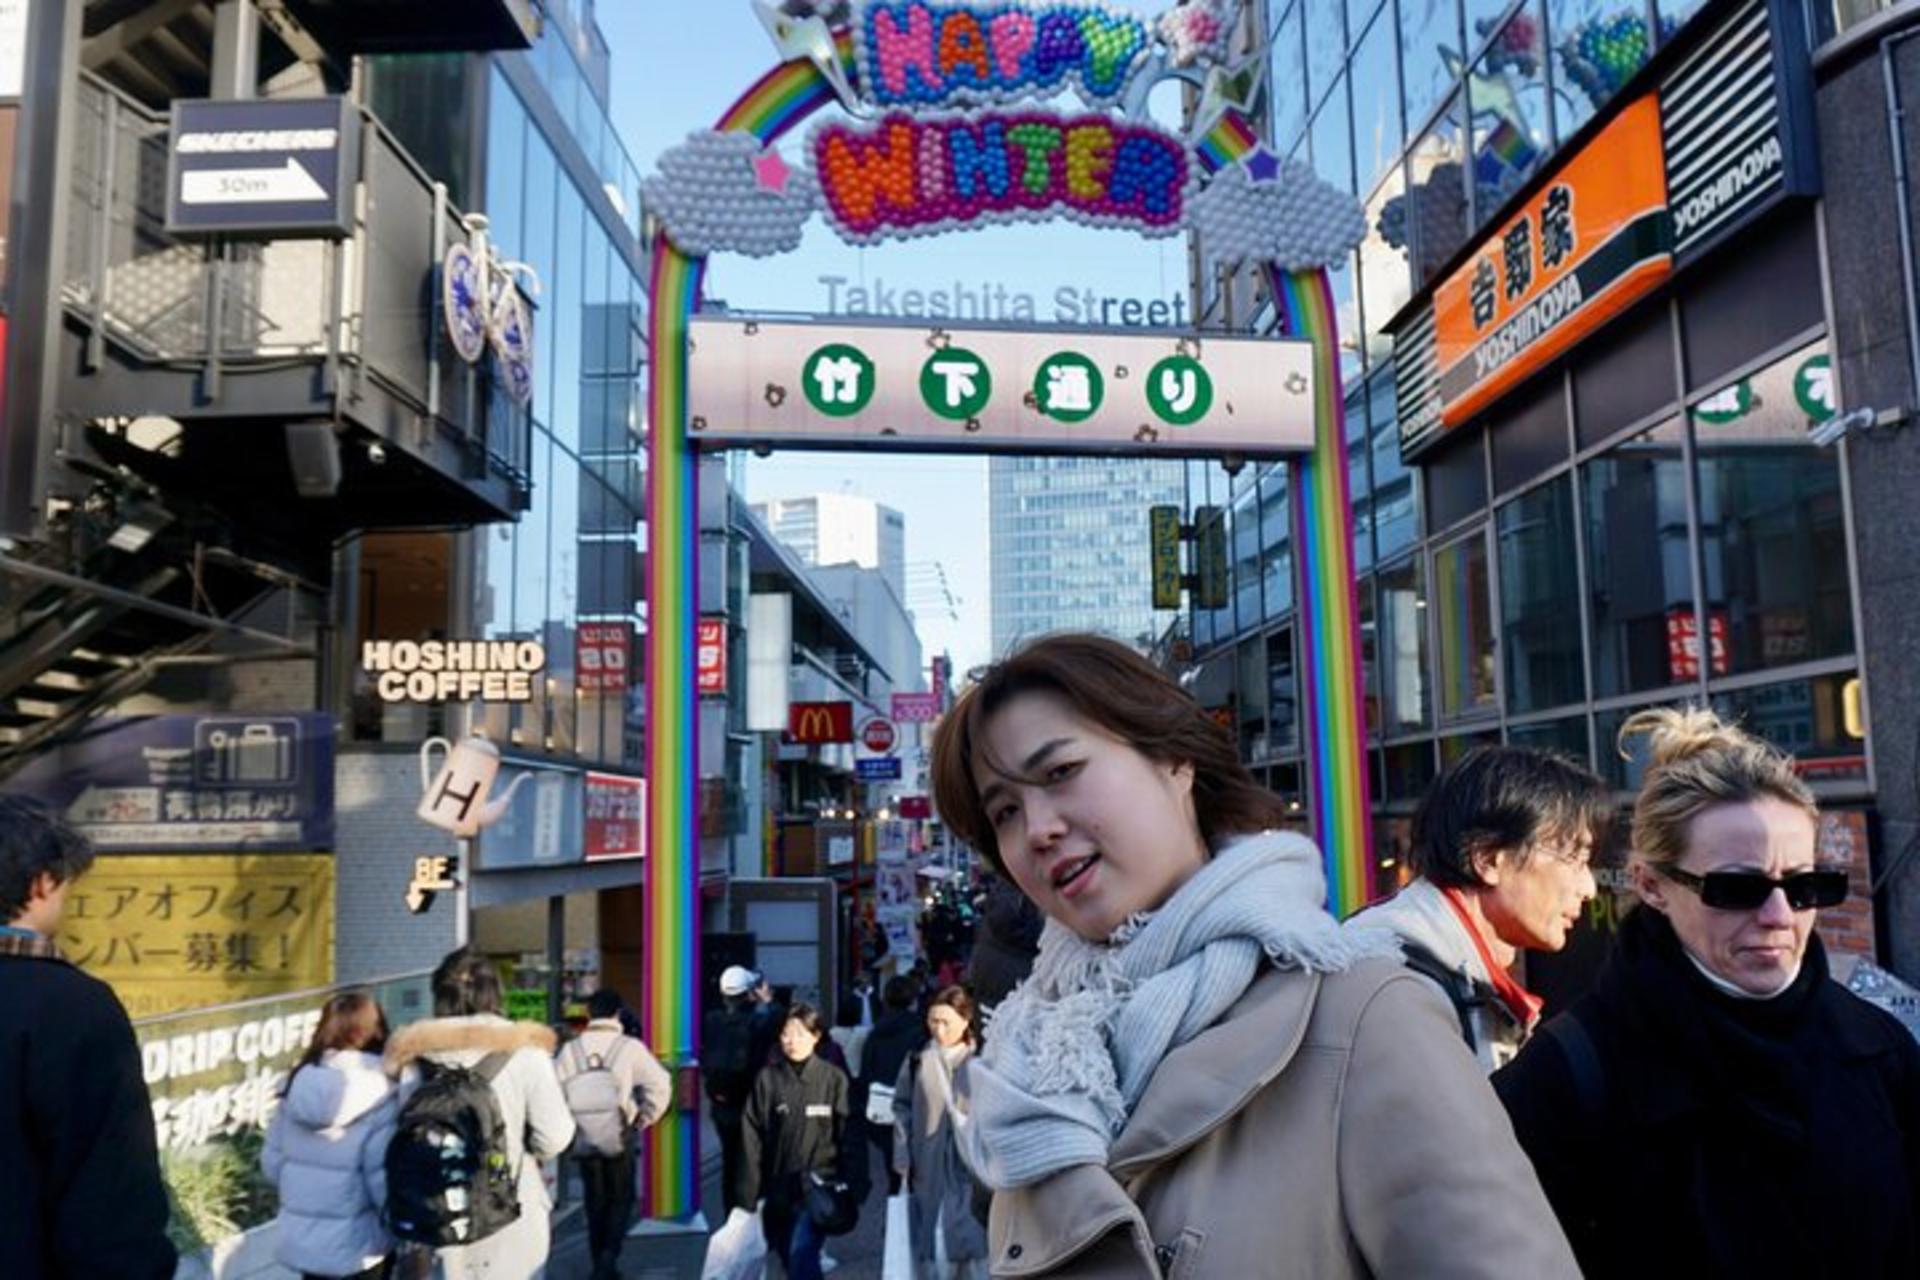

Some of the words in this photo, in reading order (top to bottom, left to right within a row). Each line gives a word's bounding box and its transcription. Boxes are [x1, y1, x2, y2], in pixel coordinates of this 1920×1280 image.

[874, 4, 1136, 94] HAPPY
[826, 121, 1177, 218] WINTER
[1673, 135, 1783, 237] YOSHINOYA
[818, 276, 1037, 320] Takeshita
[1054, 286, 1186, 326] Street
[1475, 272, 1582, 379] YOSHINOYA
[813, 355, 1198, 414] 竹下通り
[362, 640, 545, 671] HOSHINO
[377, 671, 532, 701] COFFEE
[431, 771, 480, 822] H
[143, 1028, 234, 1084] DRIP
